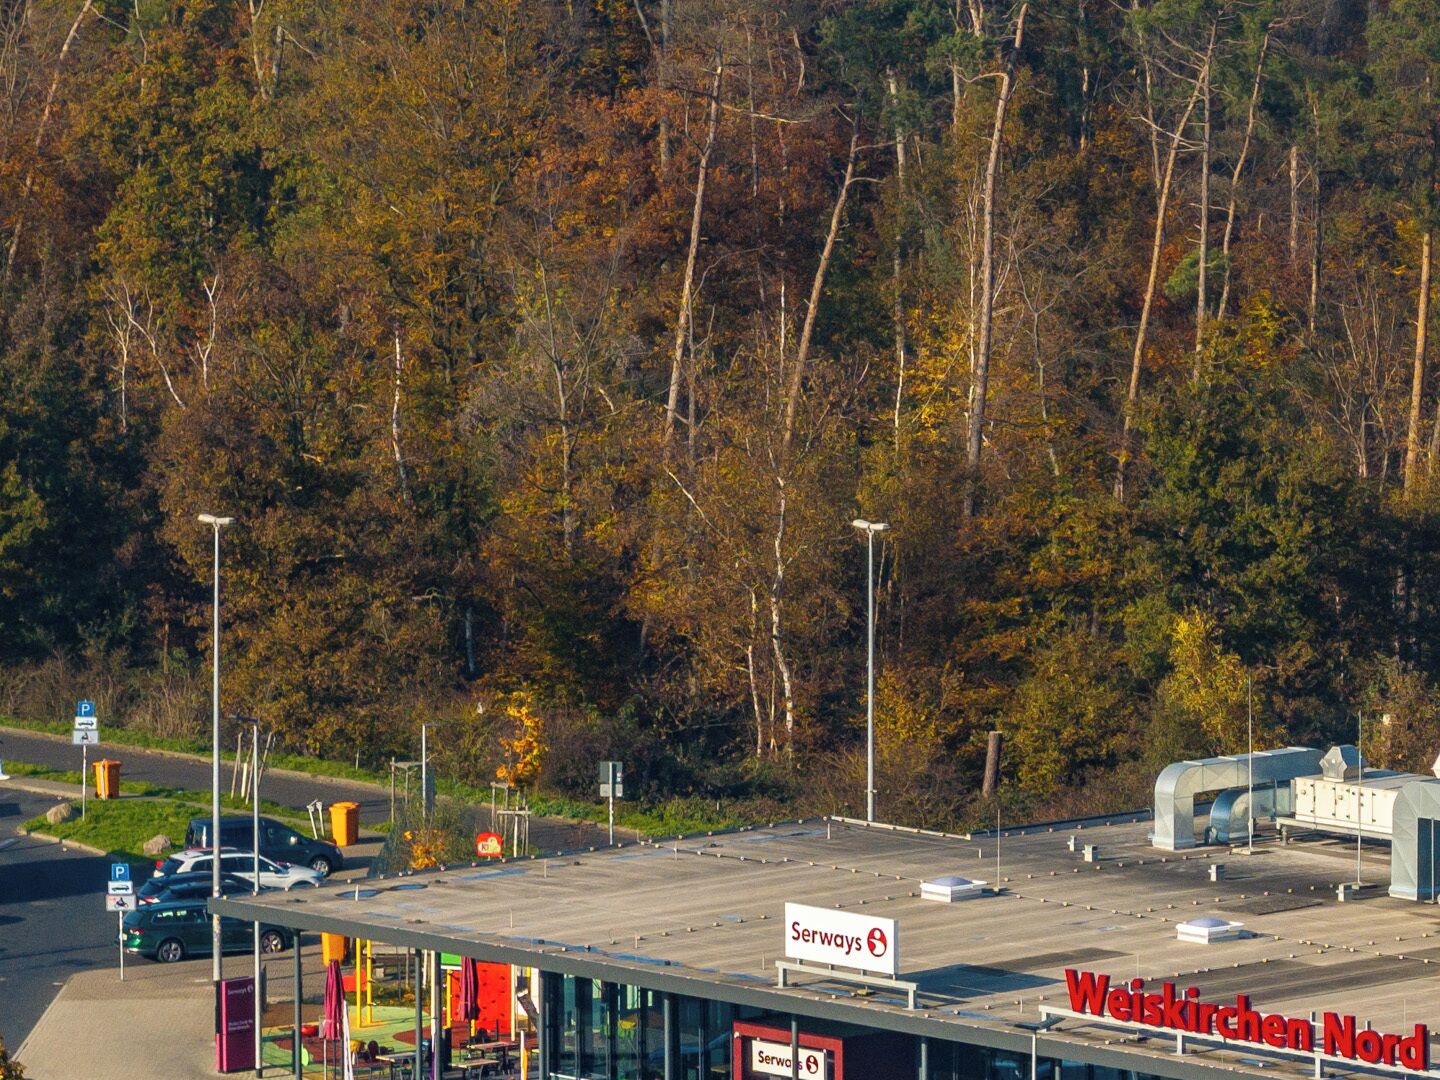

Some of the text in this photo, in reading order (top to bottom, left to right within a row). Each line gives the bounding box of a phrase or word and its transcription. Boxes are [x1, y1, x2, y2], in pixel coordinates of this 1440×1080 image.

[82, 703, 91, 716] P
[115, 866, 125, 879] P
[791, 921, 862, 955] Serways
[1065, 968, 1429, 1071] Weiskirchen Nord
[758, 1050, 803, 1071] Serwas
